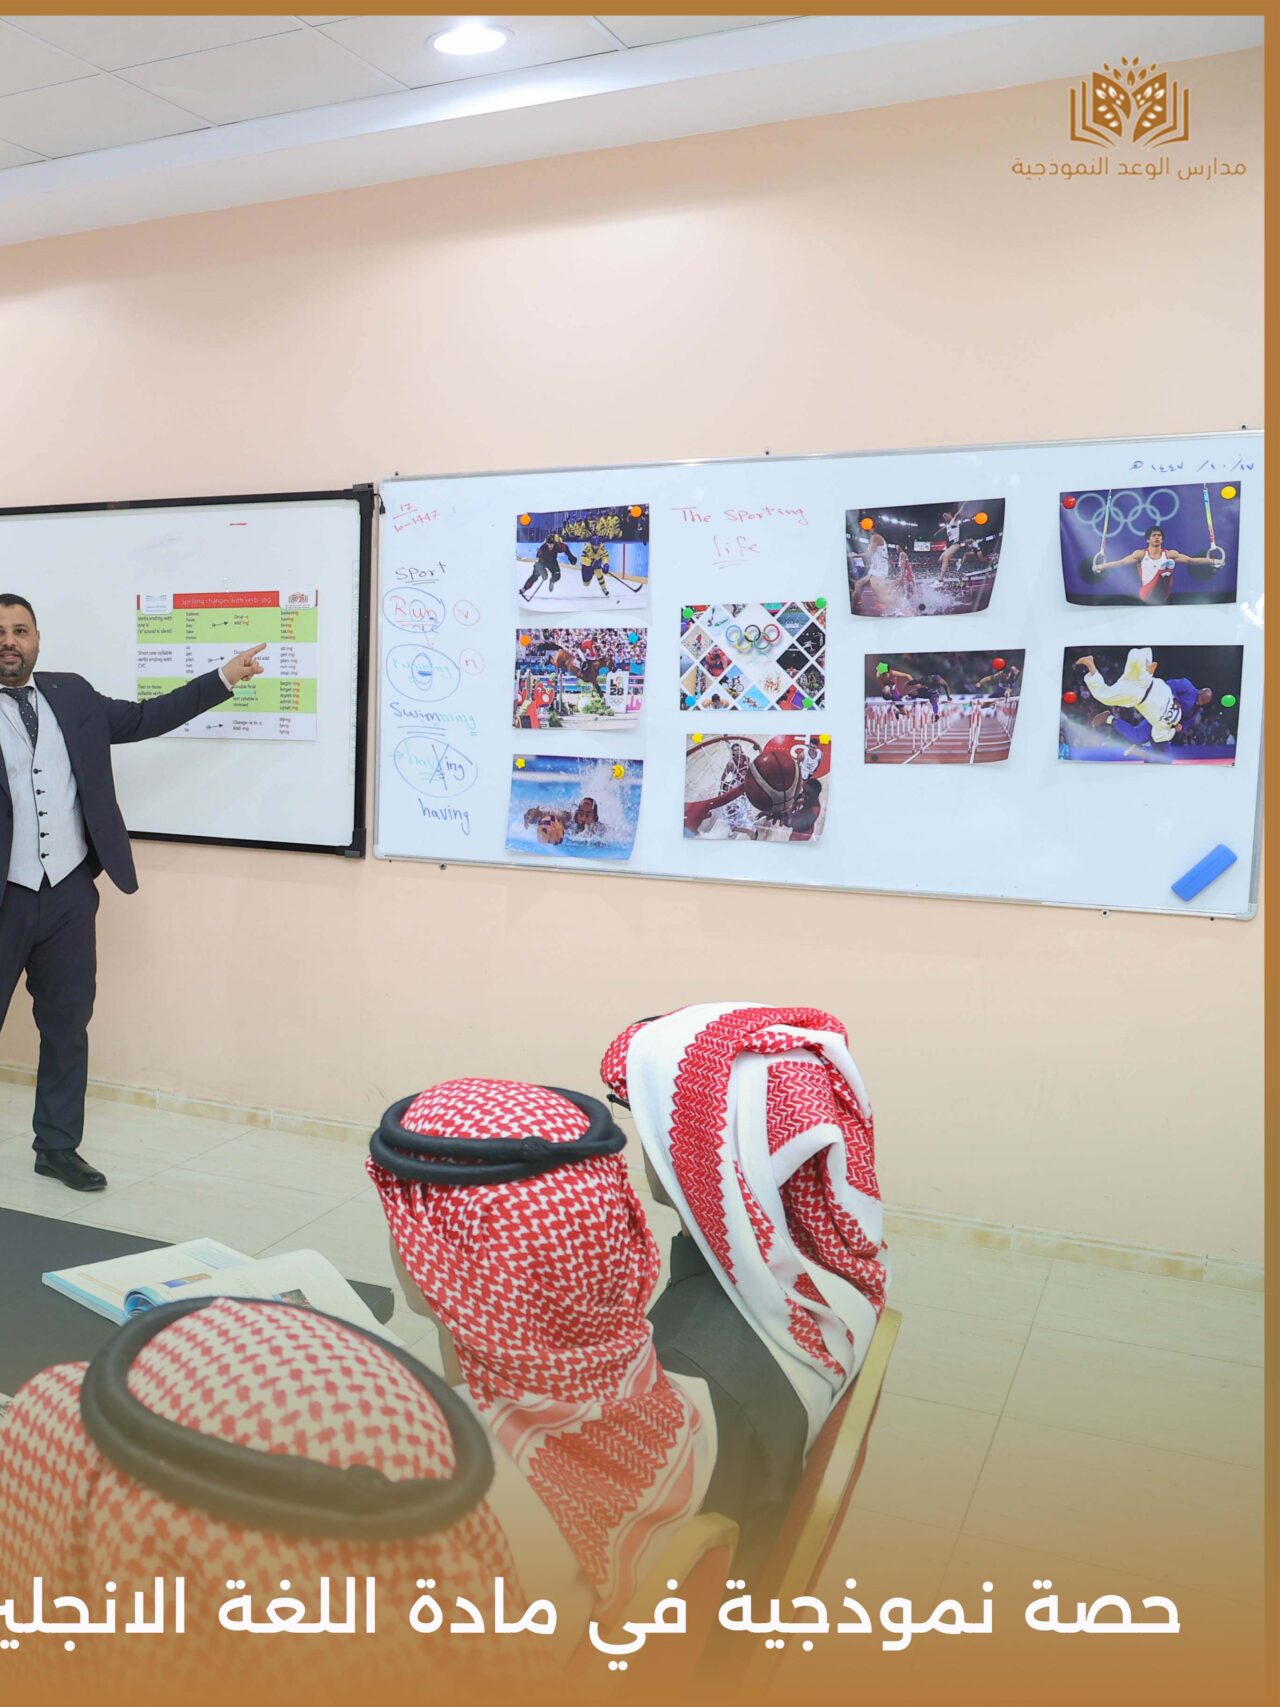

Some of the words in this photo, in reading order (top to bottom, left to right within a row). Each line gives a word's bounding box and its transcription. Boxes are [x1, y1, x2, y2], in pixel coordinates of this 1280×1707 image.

[671, 506, 712, 523] The
[724, 505, 809, 526] Sporting
[713, 535, 760, 557] life
[609, 687, 624, 696] 28
[417, 797, 470, 836] having
